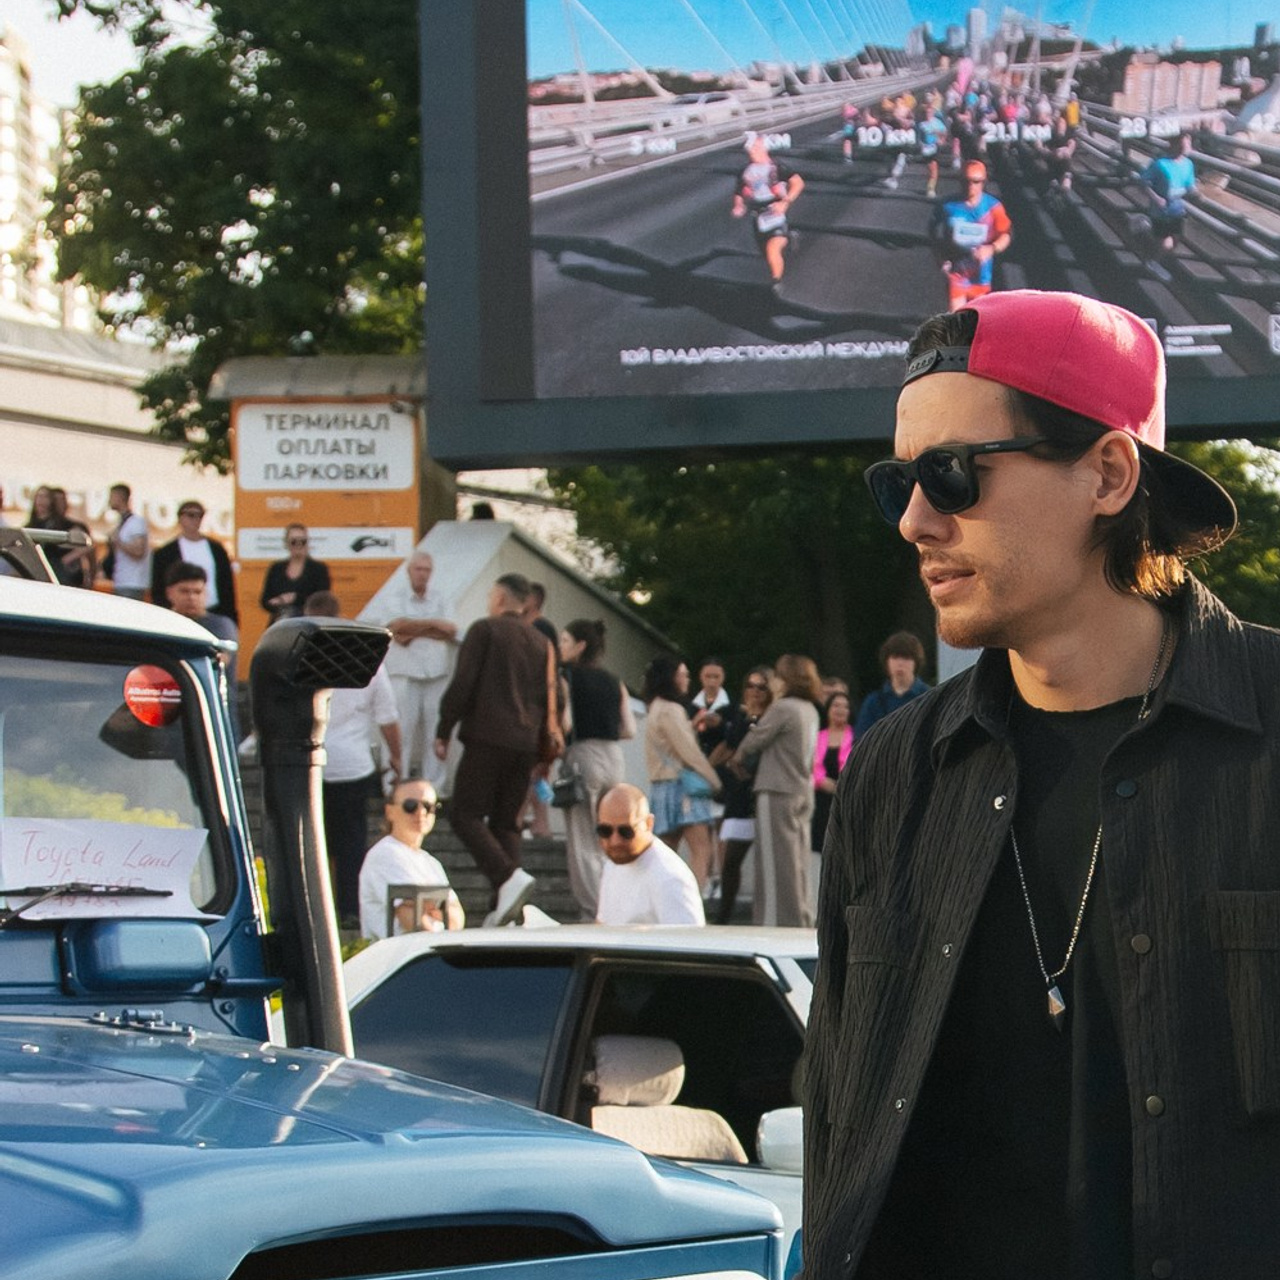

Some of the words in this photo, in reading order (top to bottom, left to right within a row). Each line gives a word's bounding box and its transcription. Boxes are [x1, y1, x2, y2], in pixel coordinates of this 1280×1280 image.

[983, 121, 1018, 143] 21.1
[1118, 116, 1147, 138] 28
[856, 126, 884, 147] 10
[826, 341, 909, 359] МЕЖДУНА
[263, 413, 390, 431] ТЕРМИНАЛ
[277, 438, 376, 455] ОПЛАТЫ
[263, 463, 388, 480] ПАРКОВКИ
